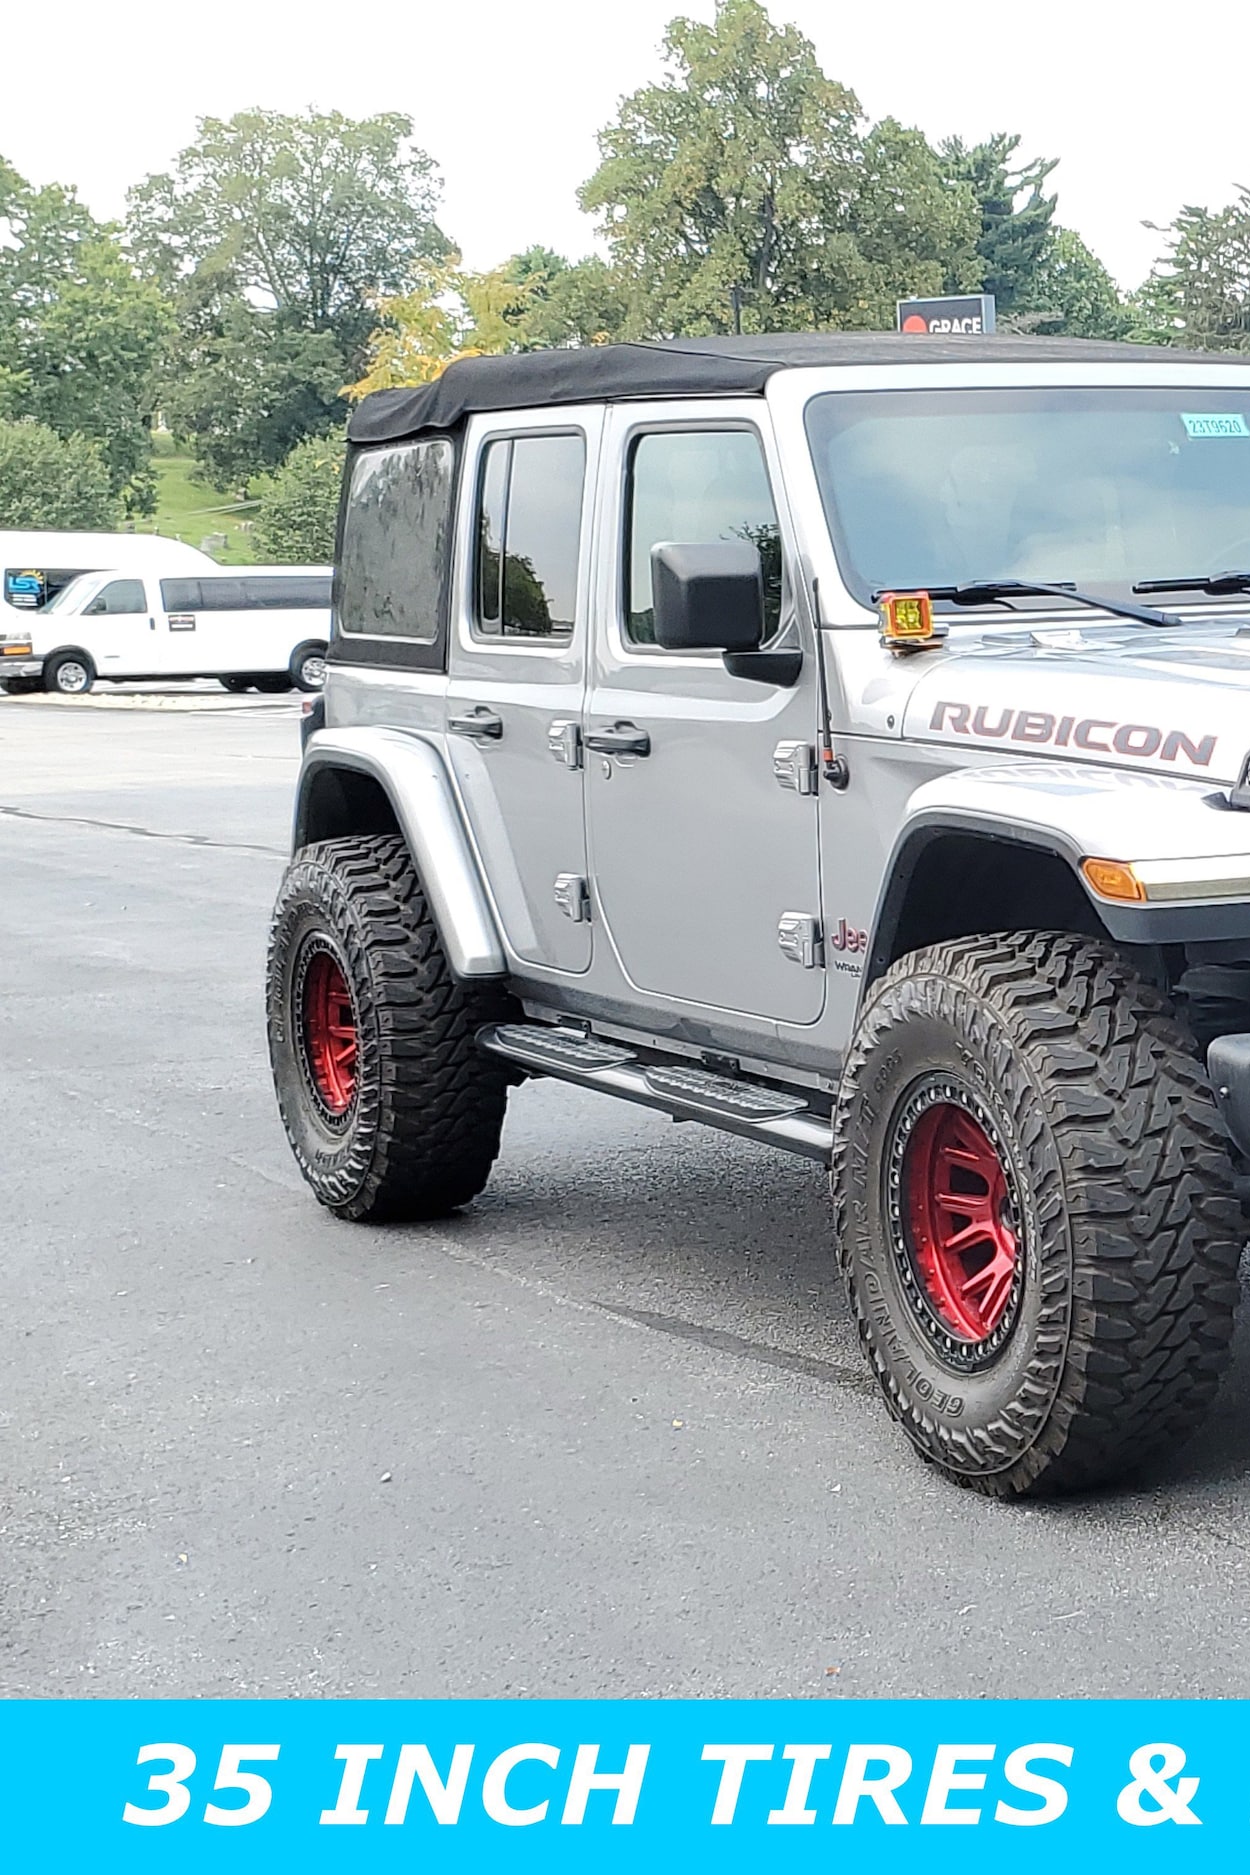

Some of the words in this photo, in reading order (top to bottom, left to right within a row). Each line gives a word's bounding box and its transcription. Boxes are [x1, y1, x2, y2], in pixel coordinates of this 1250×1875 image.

[929, 317, 982, 334] GRACE
[1188, 420, 1242, 433] 23T9620
[929, 701, 1218, 767] RUBICON
[831, 917, 868, 953] Jee
[852, 1200, 965, 1417] GEOLANDAR
